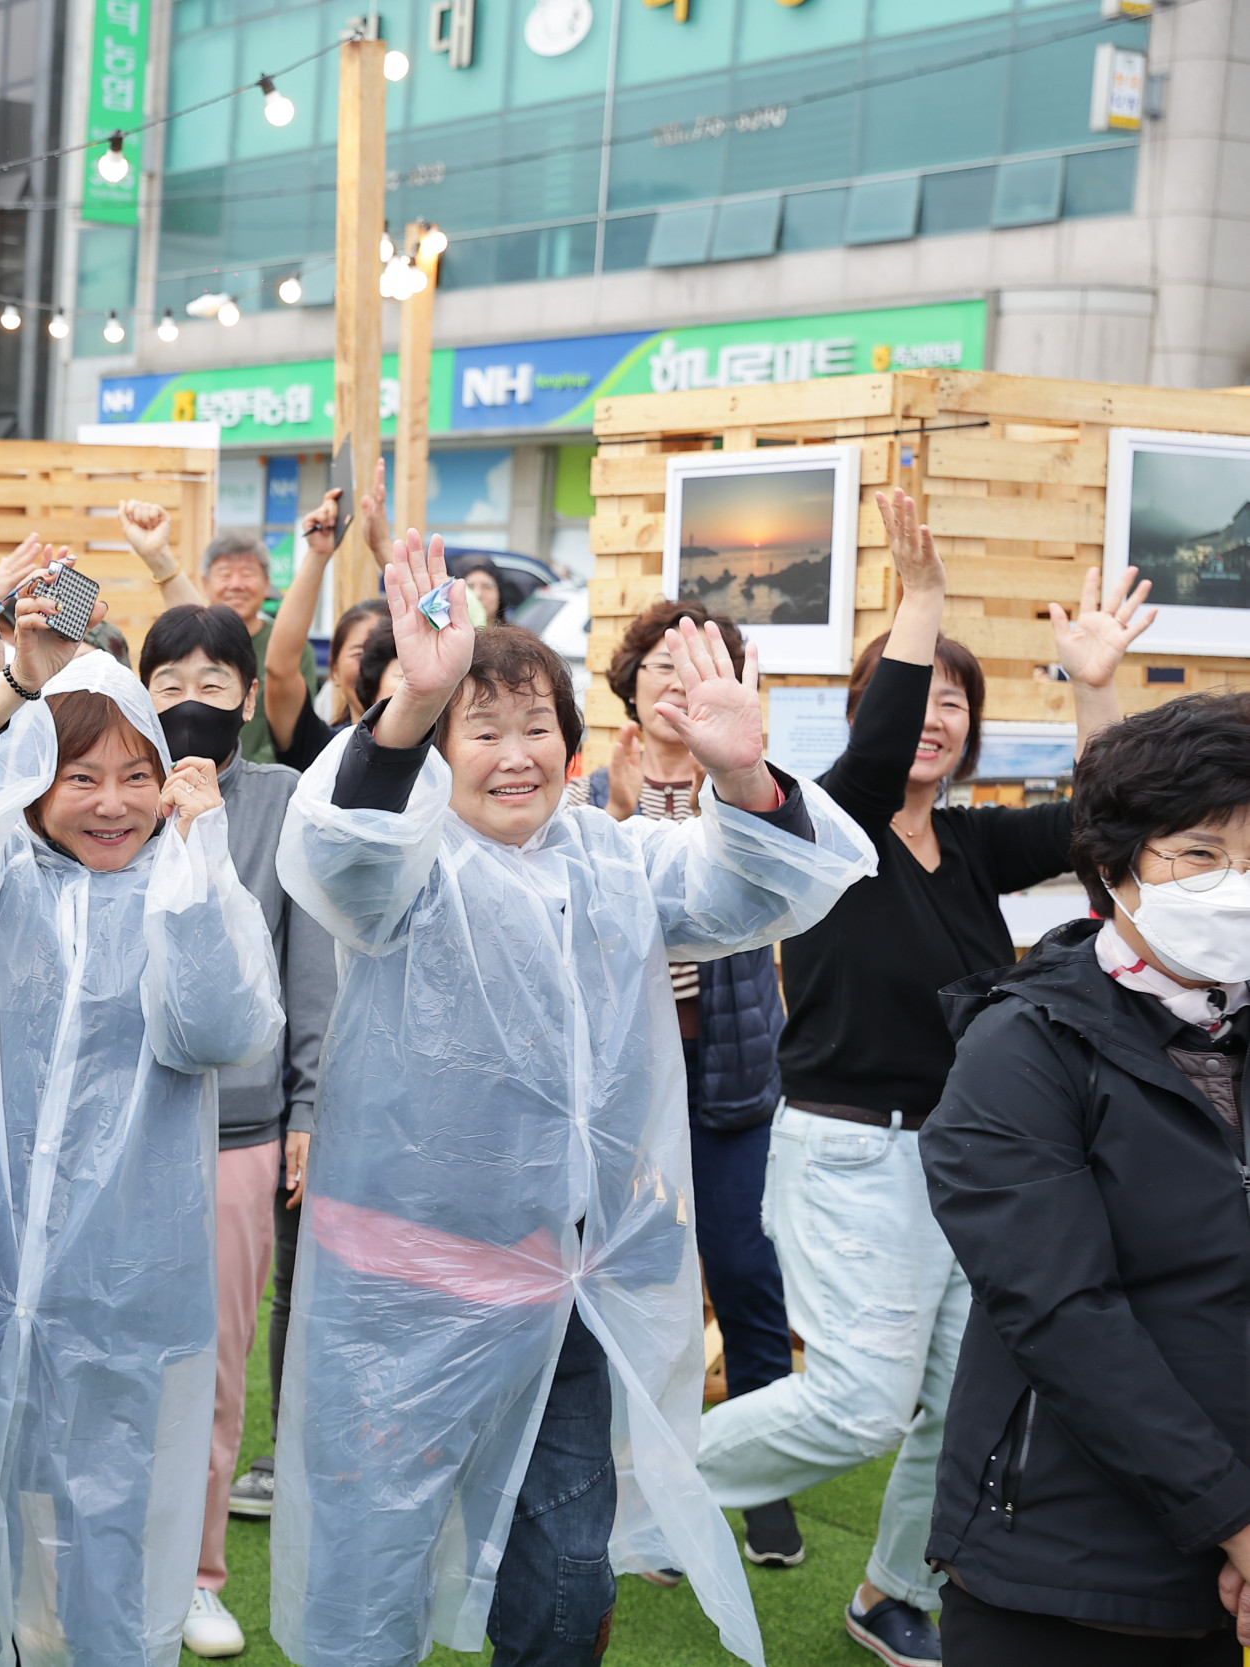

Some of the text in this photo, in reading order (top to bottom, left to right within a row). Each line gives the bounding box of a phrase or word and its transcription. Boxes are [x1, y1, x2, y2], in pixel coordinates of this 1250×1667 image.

[462, 362, 535, 409] NH
[648, 337, 855, 394] 하나로마트
[101, 388, 135, 413] NH
